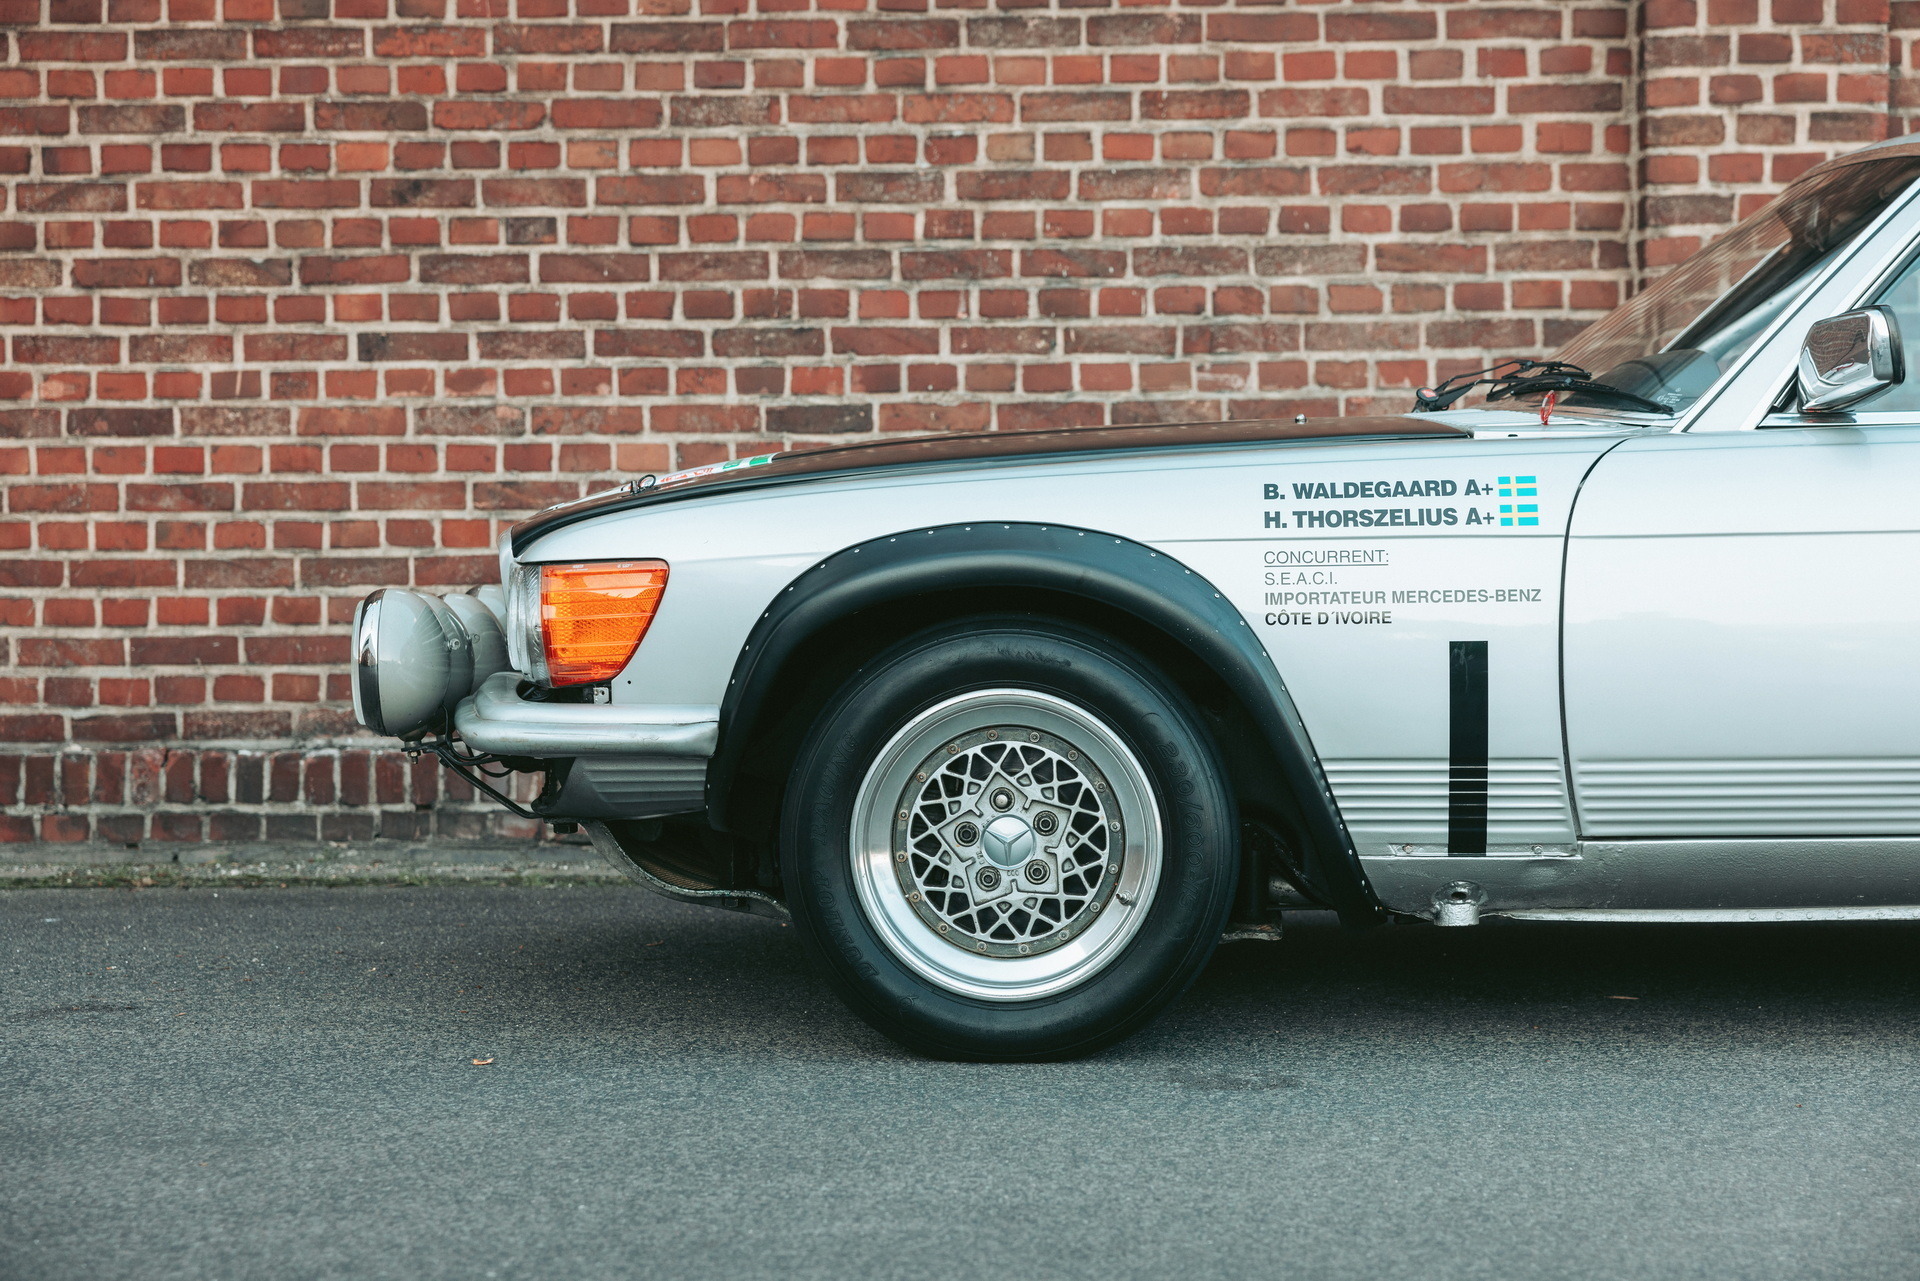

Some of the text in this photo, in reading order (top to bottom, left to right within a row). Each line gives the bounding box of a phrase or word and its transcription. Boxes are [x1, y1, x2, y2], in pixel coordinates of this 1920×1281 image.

[1263, 478, 1494, 500] B. WALDEGAARD A+
[1263, 507, 1495, 529] H. THORSZELIUS A+
[1264, 549, 1389, 566] CONCURRENT:
[1264, 571, 1338, 586] S.E.A.C.I.
[1264, 588, 1542, 606] IMPORTATEUR MERCEDES-BENZ
[1264, 608, 1313, 626] CÔTE
[813, 870, 879, 980] DUNLOP
